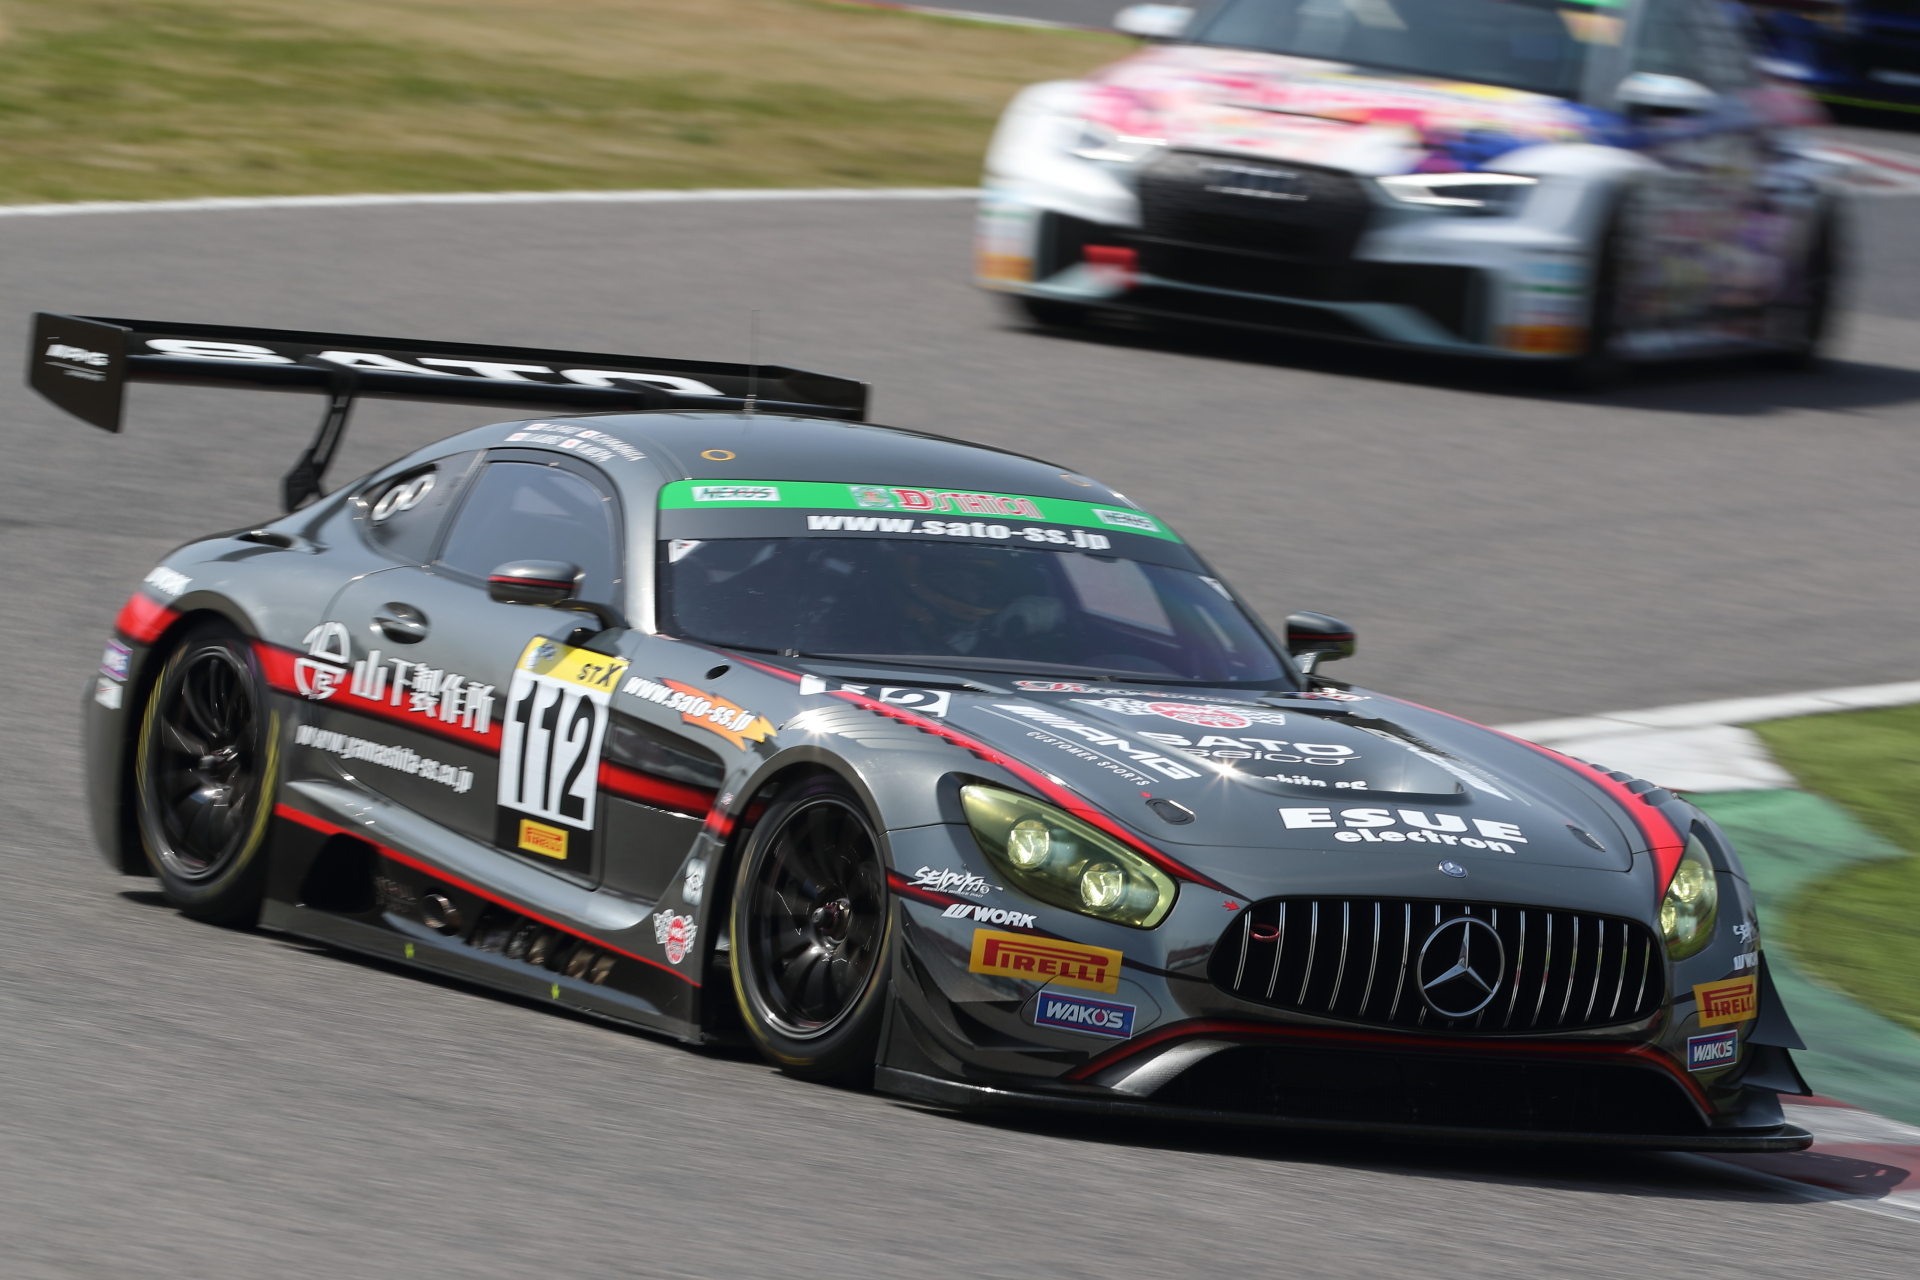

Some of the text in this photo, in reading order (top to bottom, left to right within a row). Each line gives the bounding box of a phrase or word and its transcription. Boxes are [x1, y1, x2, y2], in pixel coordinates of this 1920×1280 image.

[806, 515, 1112, 550] www.sato-ss.jp
[349, 650, 495, 734] 山下製作所
[621, 676, 756, 732] www.sato-ss.jp
[514, 680, 596, 822] 112
[1026, 731, 1151, 786] CUSTOMER SPORTS
[1136, 731, 1355, 756] SATO
[1278, 807, 1528, 844] ESUE
[1333, 828, 1517, 854] electron
[972, 905, 1038, 929] WORK
[983, 938, 1109, 983] PIRELLI
